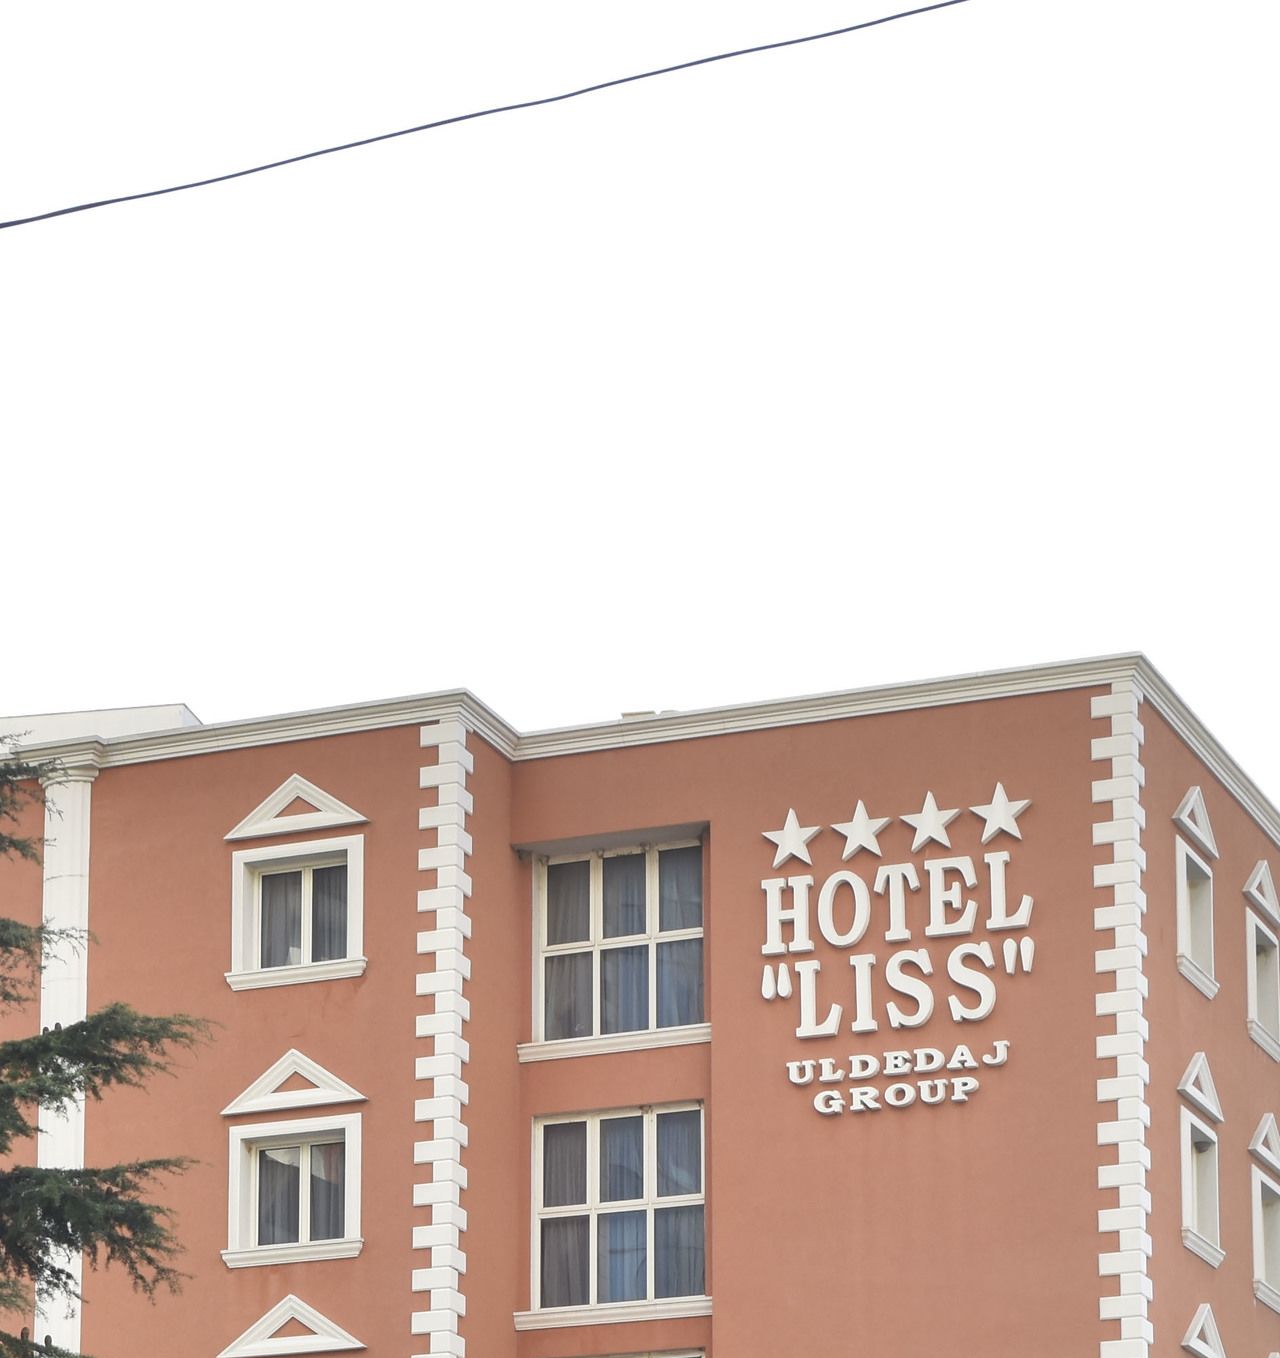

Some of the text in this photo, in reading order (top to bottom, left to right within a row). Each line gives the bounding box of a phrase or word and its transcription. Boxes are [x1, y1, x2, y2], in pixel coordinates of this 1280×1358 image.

[761, 851, 1034, 956] HOTEL
[761, 936, 1035, 1040] "LISS"
[787, 1041, 1010, 1086] ULDEDAJ
[813, 1076, 979, 1115] GROUP
